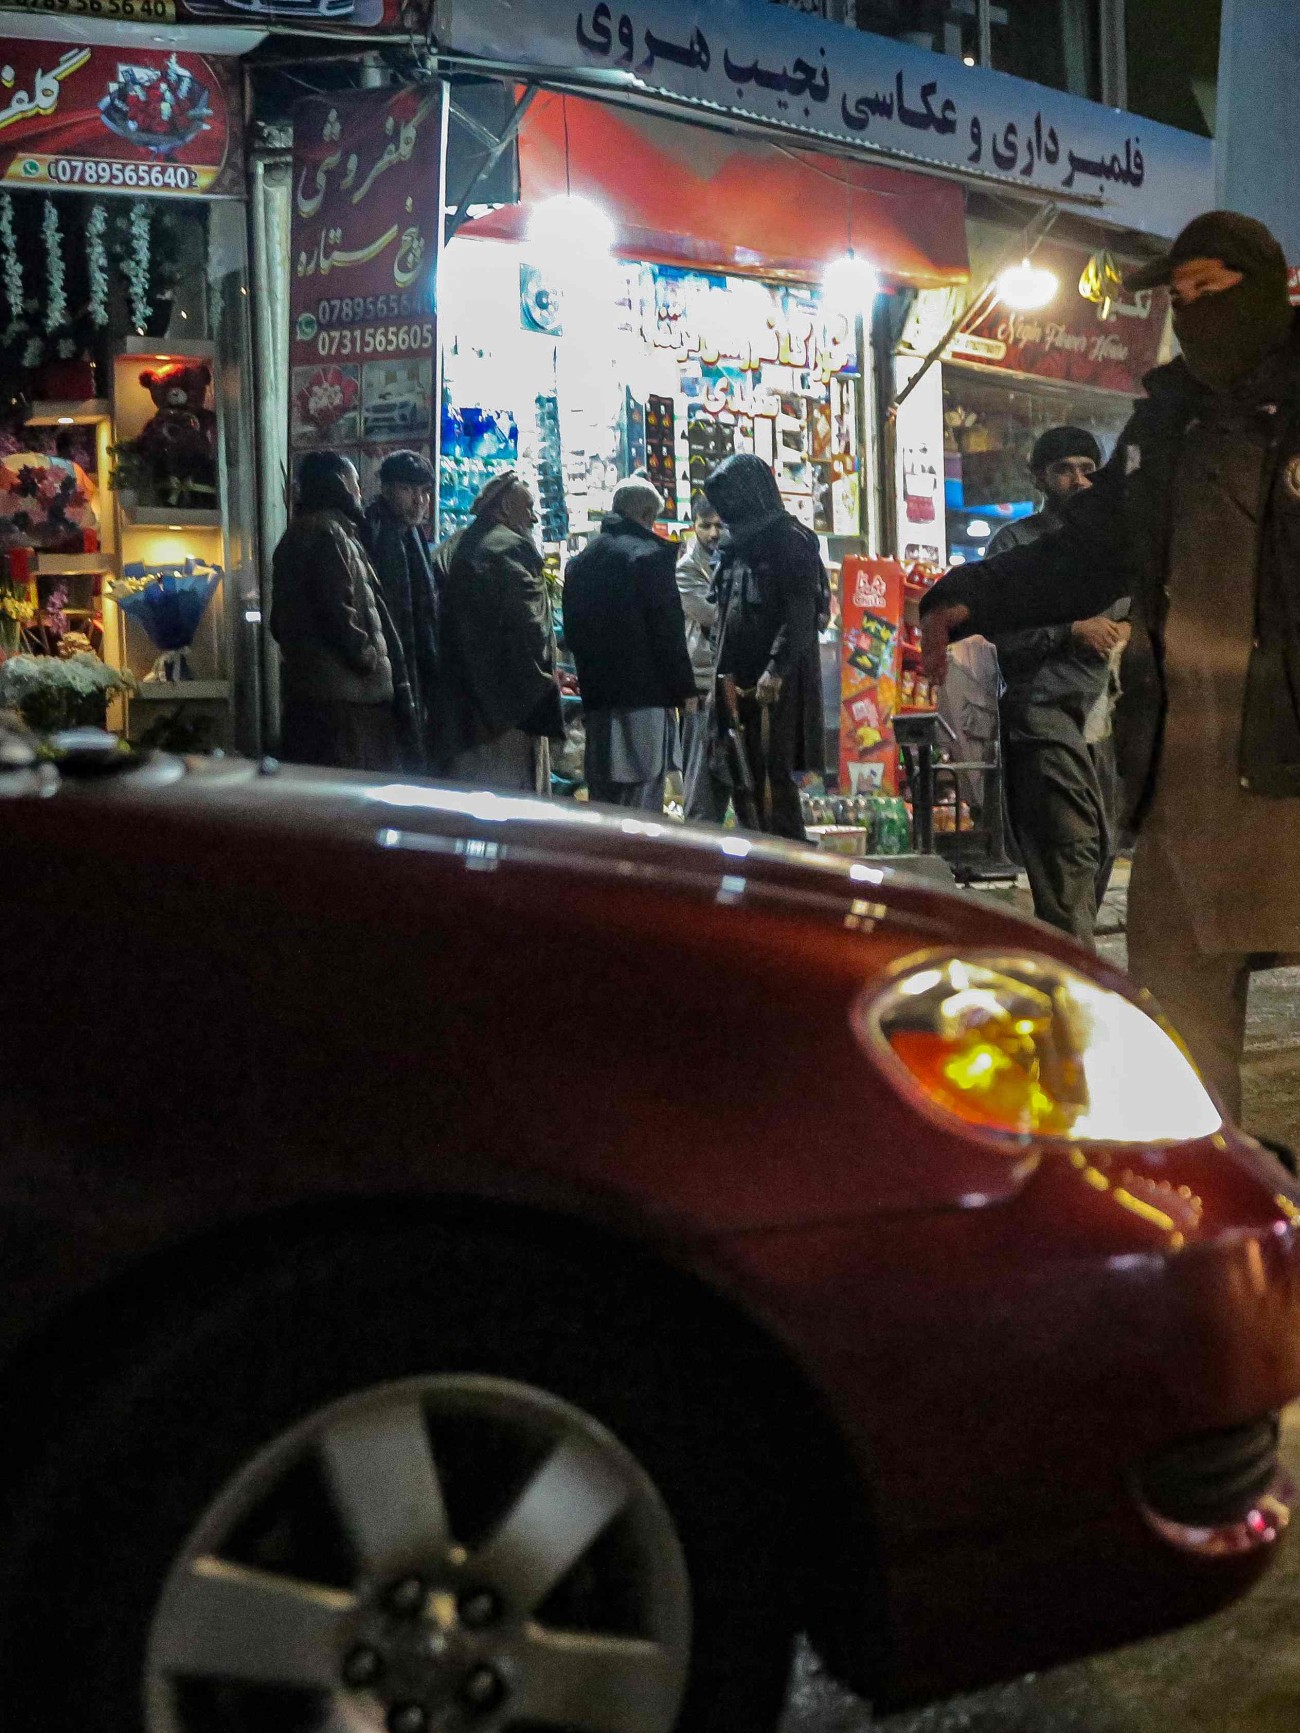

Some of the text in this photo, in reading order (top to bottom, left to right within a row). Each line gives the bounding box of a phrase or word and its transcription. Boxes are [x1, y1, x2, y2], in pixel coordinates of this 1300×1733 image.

[576, 2, 711, 74] هروی
[723, 46, 830, 118] نجیب
[841, 69, 957, 134] عکاسی
[967, 115, 983, 164] و
[56, 160, 190, 190] 0789565640
[317, 323, 433, 357] 0731565605
